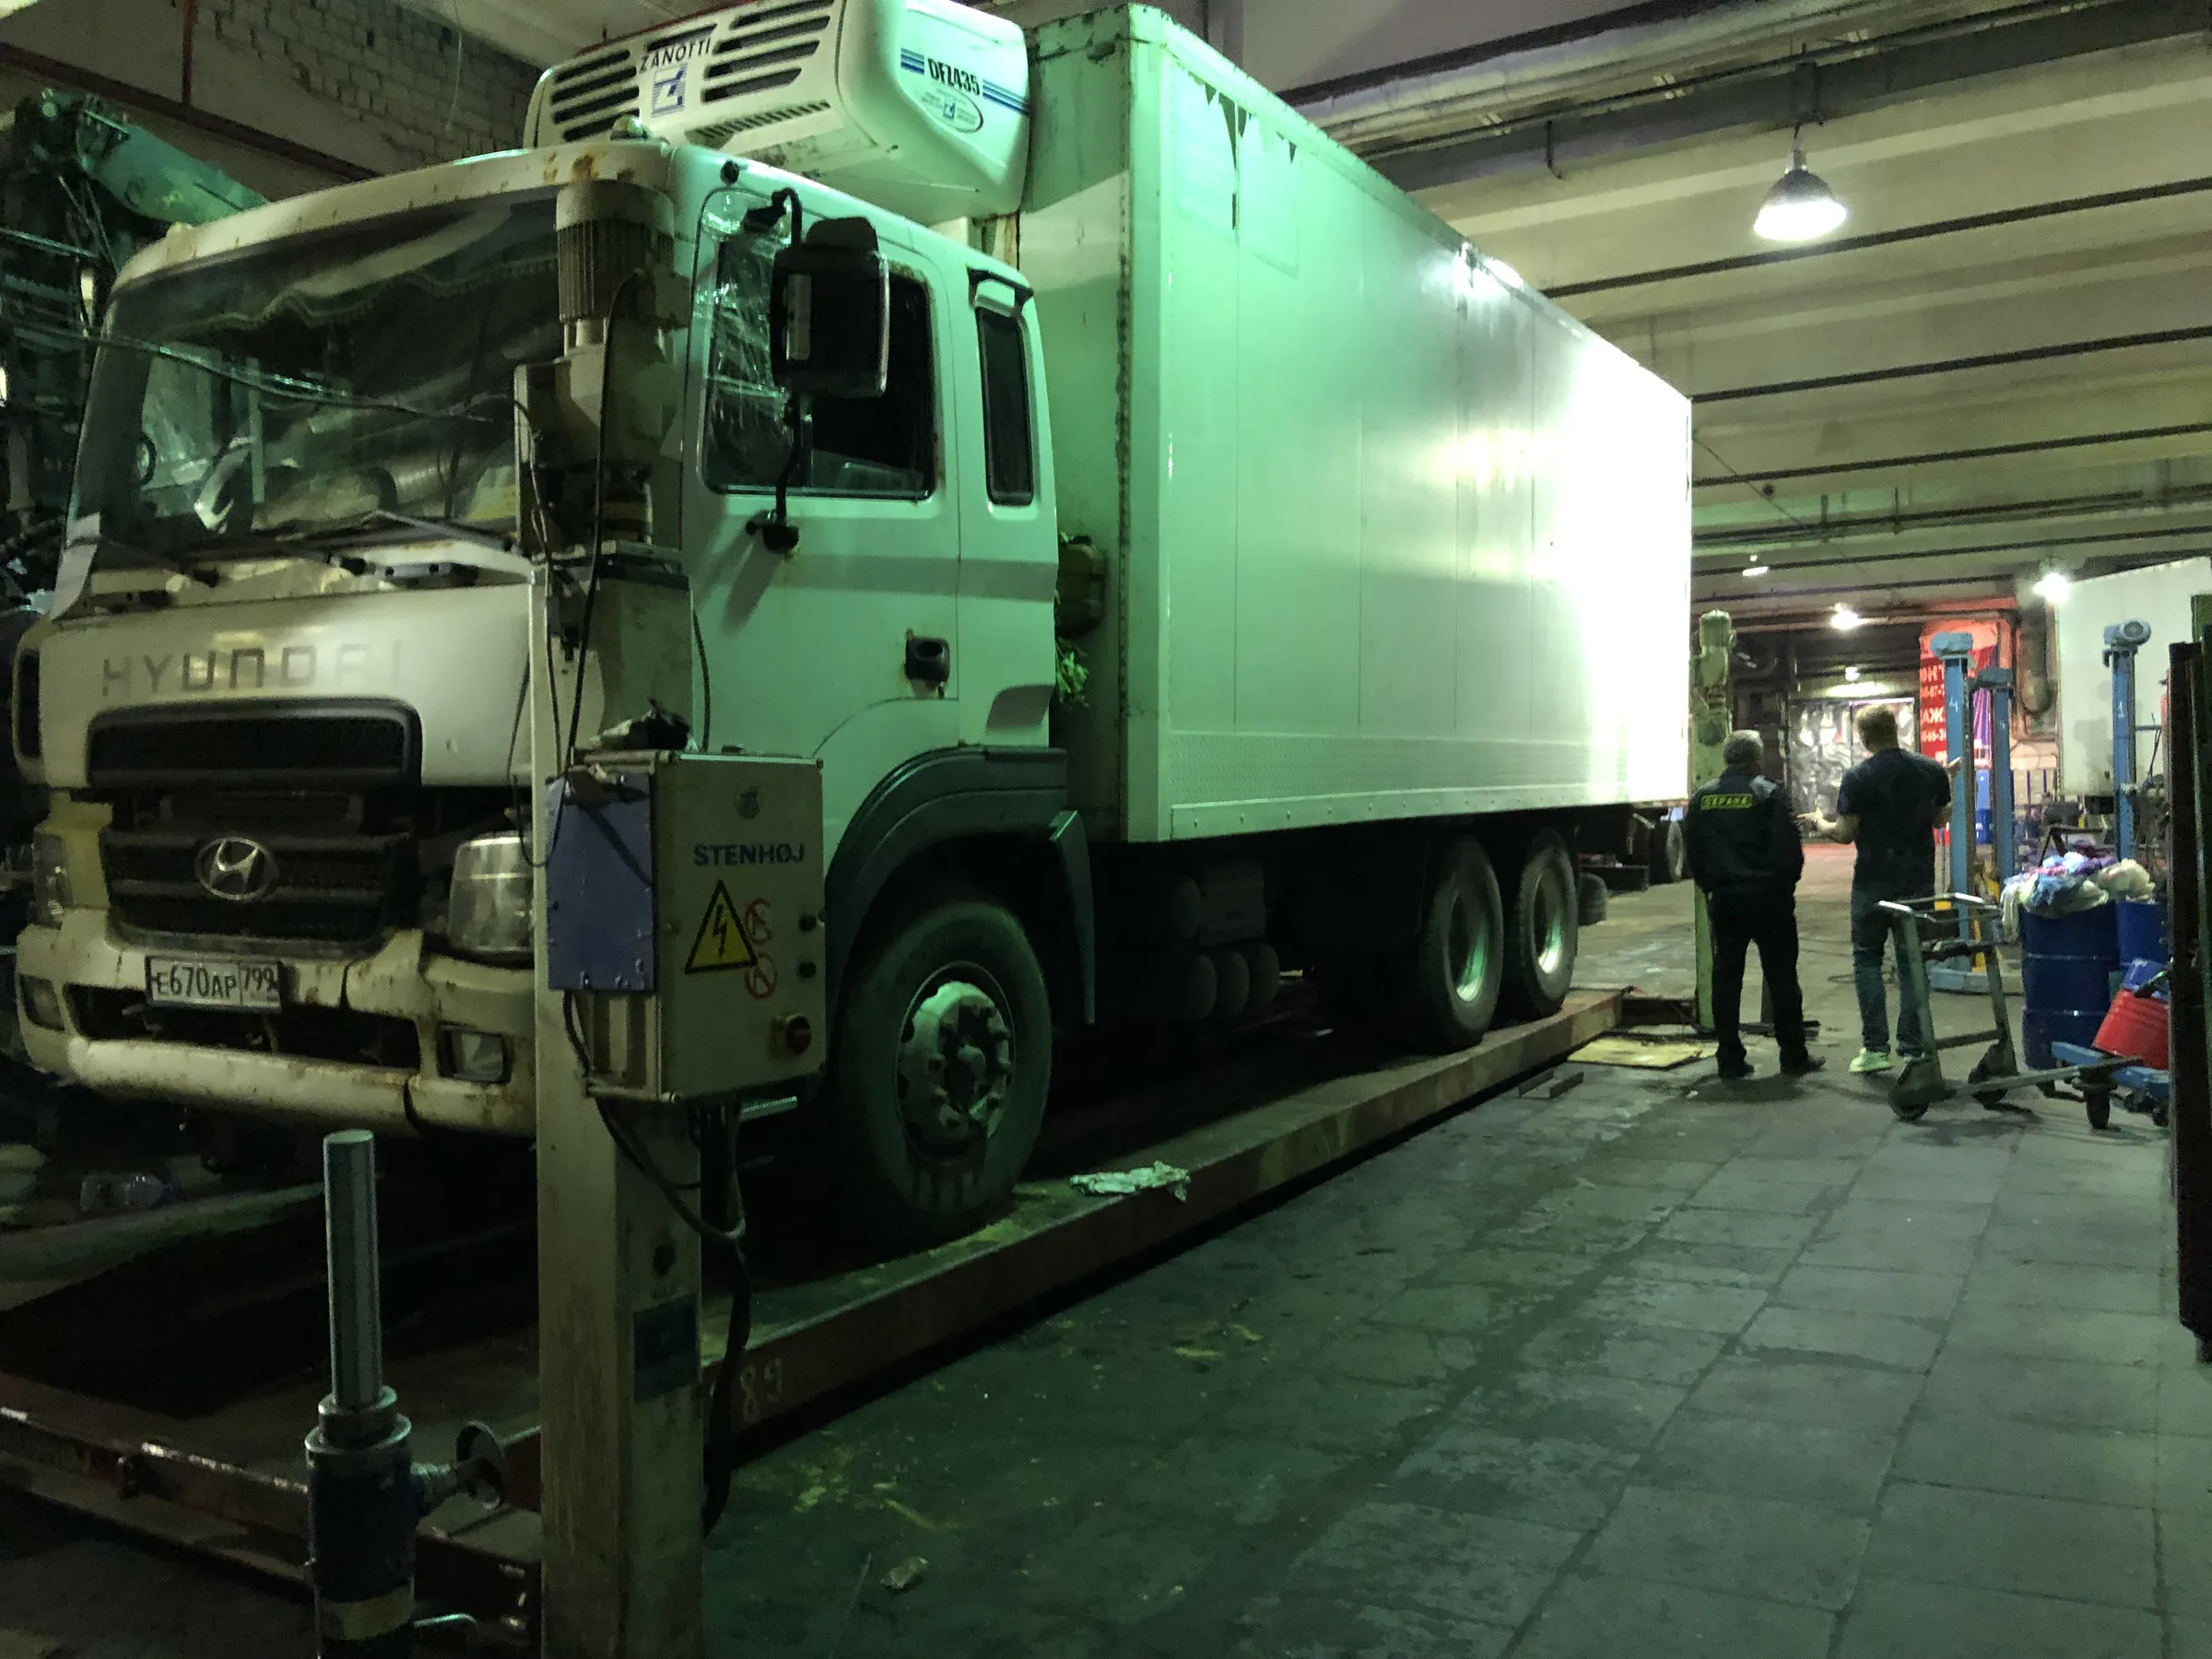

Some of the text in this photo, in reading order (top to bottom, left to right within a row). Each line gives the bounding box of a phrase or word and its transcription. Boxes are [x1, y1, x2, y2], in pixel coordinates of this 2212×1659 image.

[640, 38, 711, 74] ZANOTTI
[102, 641, 404, 696] HYUNDAI
[693, 843, 805, 865] STENHØJ
